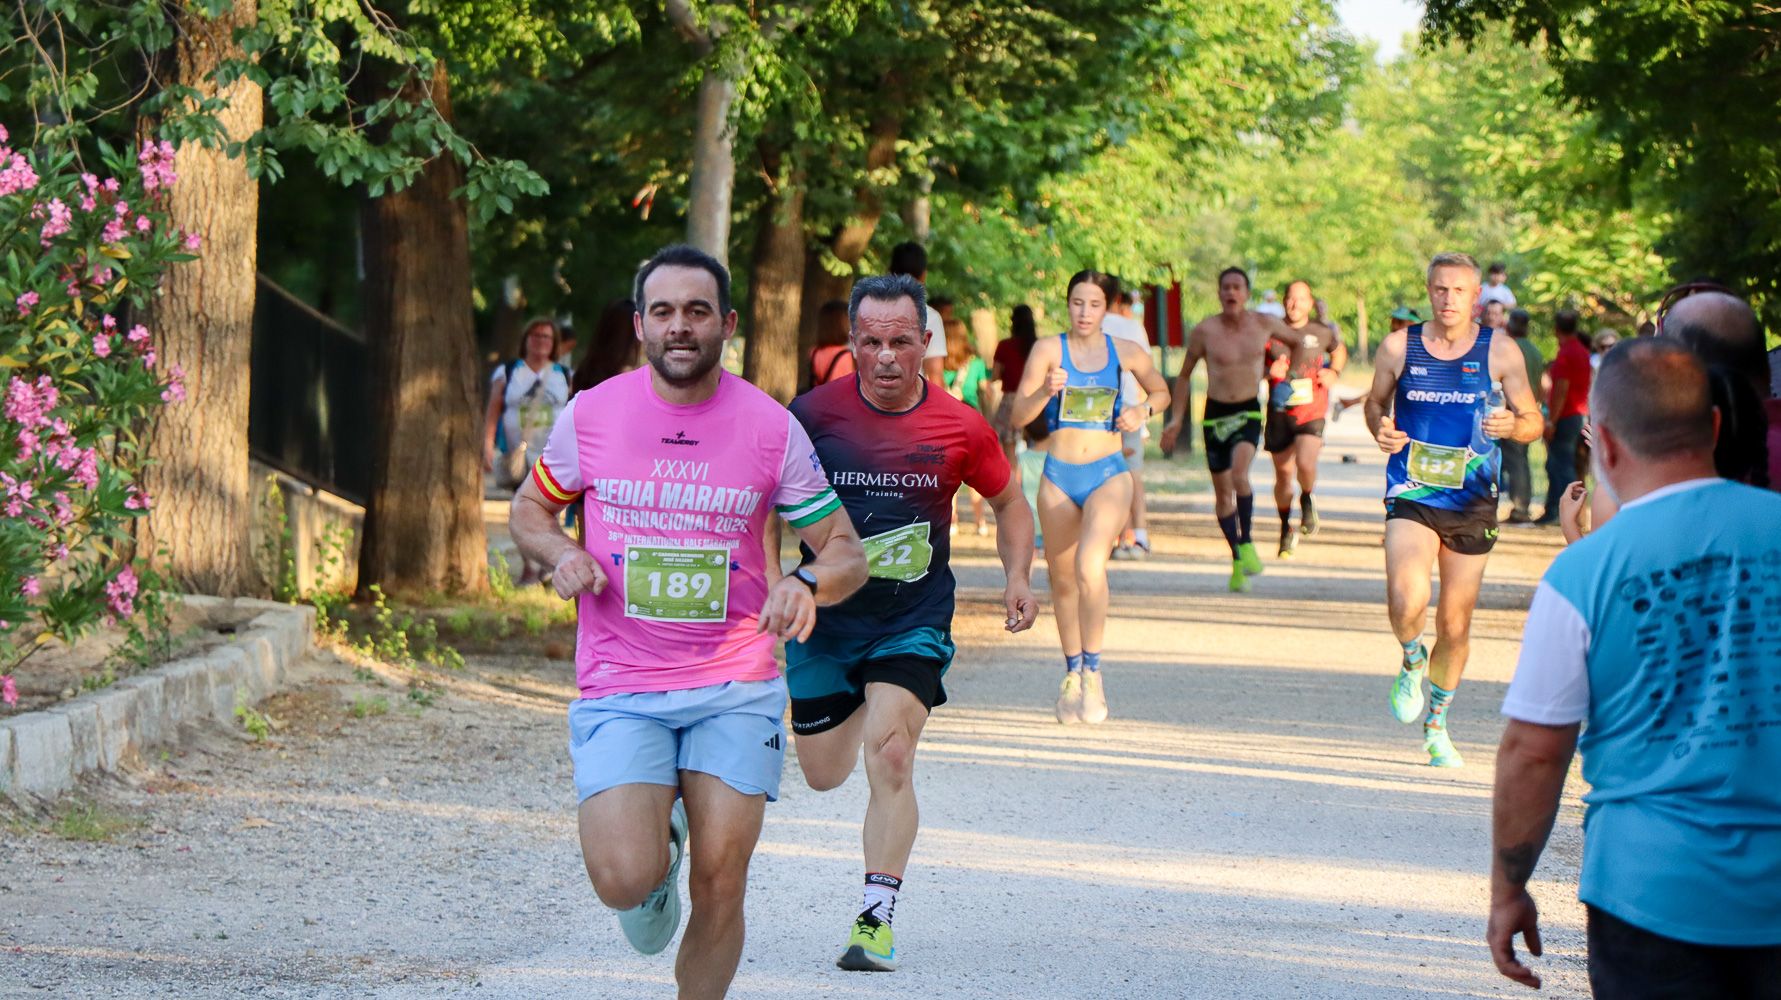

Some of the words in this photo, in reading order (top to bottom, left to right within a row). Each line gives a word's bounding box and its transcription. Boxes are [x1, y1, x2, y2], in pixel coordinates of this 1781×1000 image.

[1406, 390, 1476, 405] enerplus
[650, 458, 710, 481] XXXVI
[1419, 457, 1456, 475] 132
[833, 471, 899, 487] HERMES
[902, 473, 938, 488] GYM
[865, 490, 904, 498] Training
[602, 505, 712, 533] INTERNACIONAL
[878, 544, 913, 567] 32
[647, 571, 712, 598] 189
